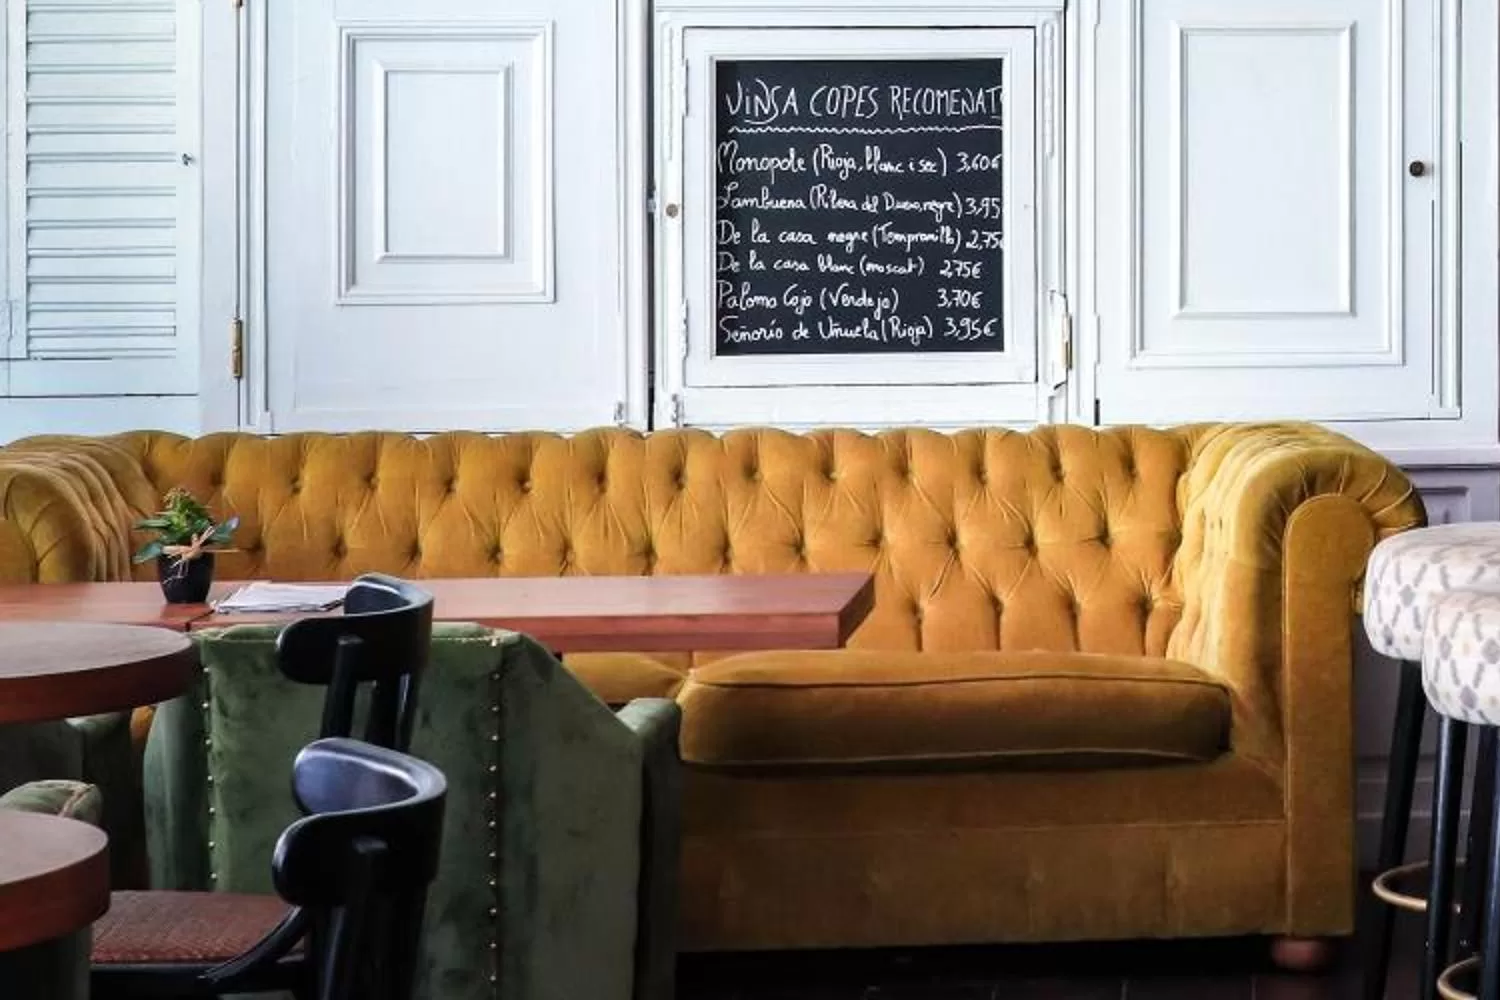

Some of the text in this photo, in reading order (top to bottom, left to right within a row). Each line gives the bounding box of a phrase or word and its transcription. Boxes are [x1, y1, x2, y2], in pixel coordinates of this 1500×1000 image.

[809, 84, 879, 119] COPES
[718, 140, 806, 184] Monopole
[719, 219, 741, 244] De
[751, 218, 770, 243] la
[779, 231, 817, 244] casa
[717, 251, 740, 272] De
[749, 250, 766, 271] la
[773, 257, 810, 272] casa
[717, 280, 777, 310] Palomo
[783, 284, 812, 314] Cojo
[792, 321, 809, 340] de
